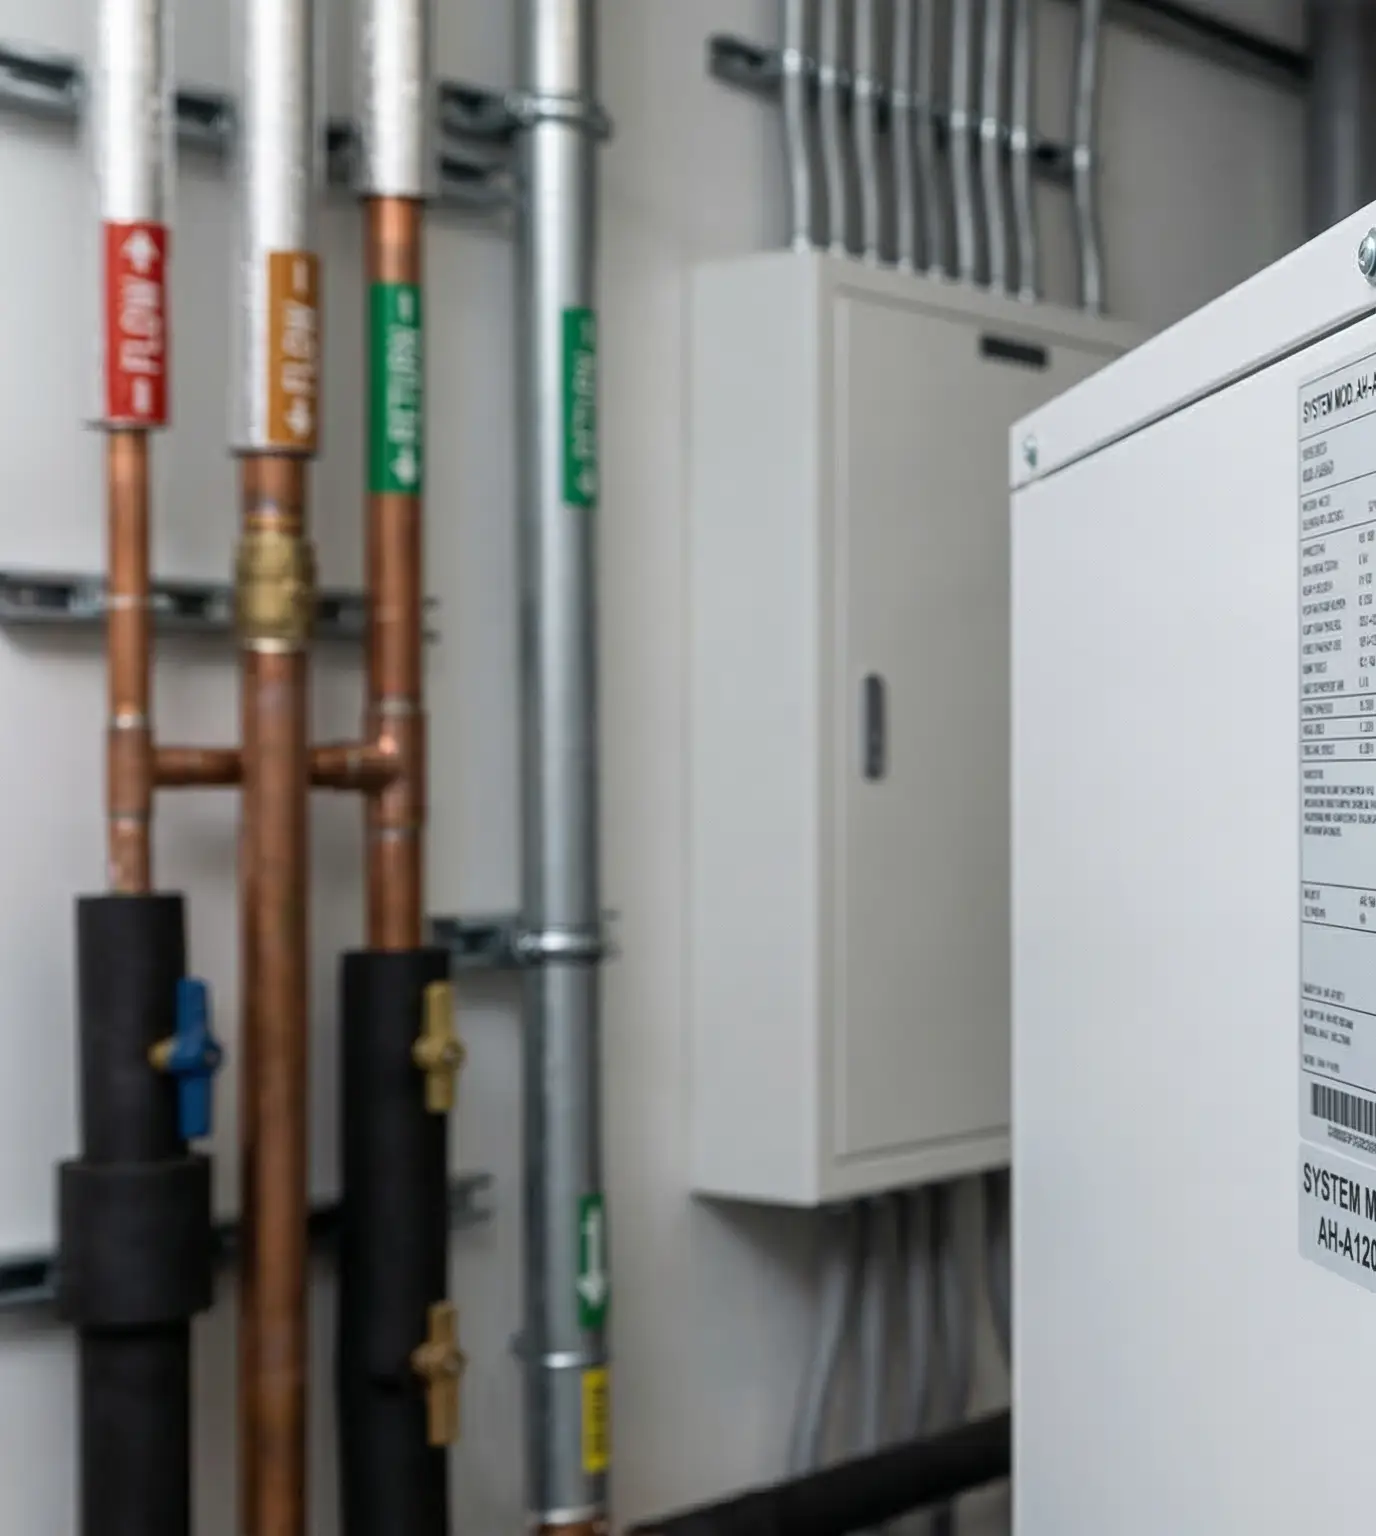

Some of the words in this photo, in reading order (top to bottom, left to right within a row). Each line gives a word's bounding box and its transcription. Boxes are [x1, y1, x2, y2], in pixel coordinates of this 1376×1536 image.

[119, 275, 161, 375] FLOW
[386, 323, 420, 444] RETURN
[1303, 1162, 1361, 1215] SYSTEM
